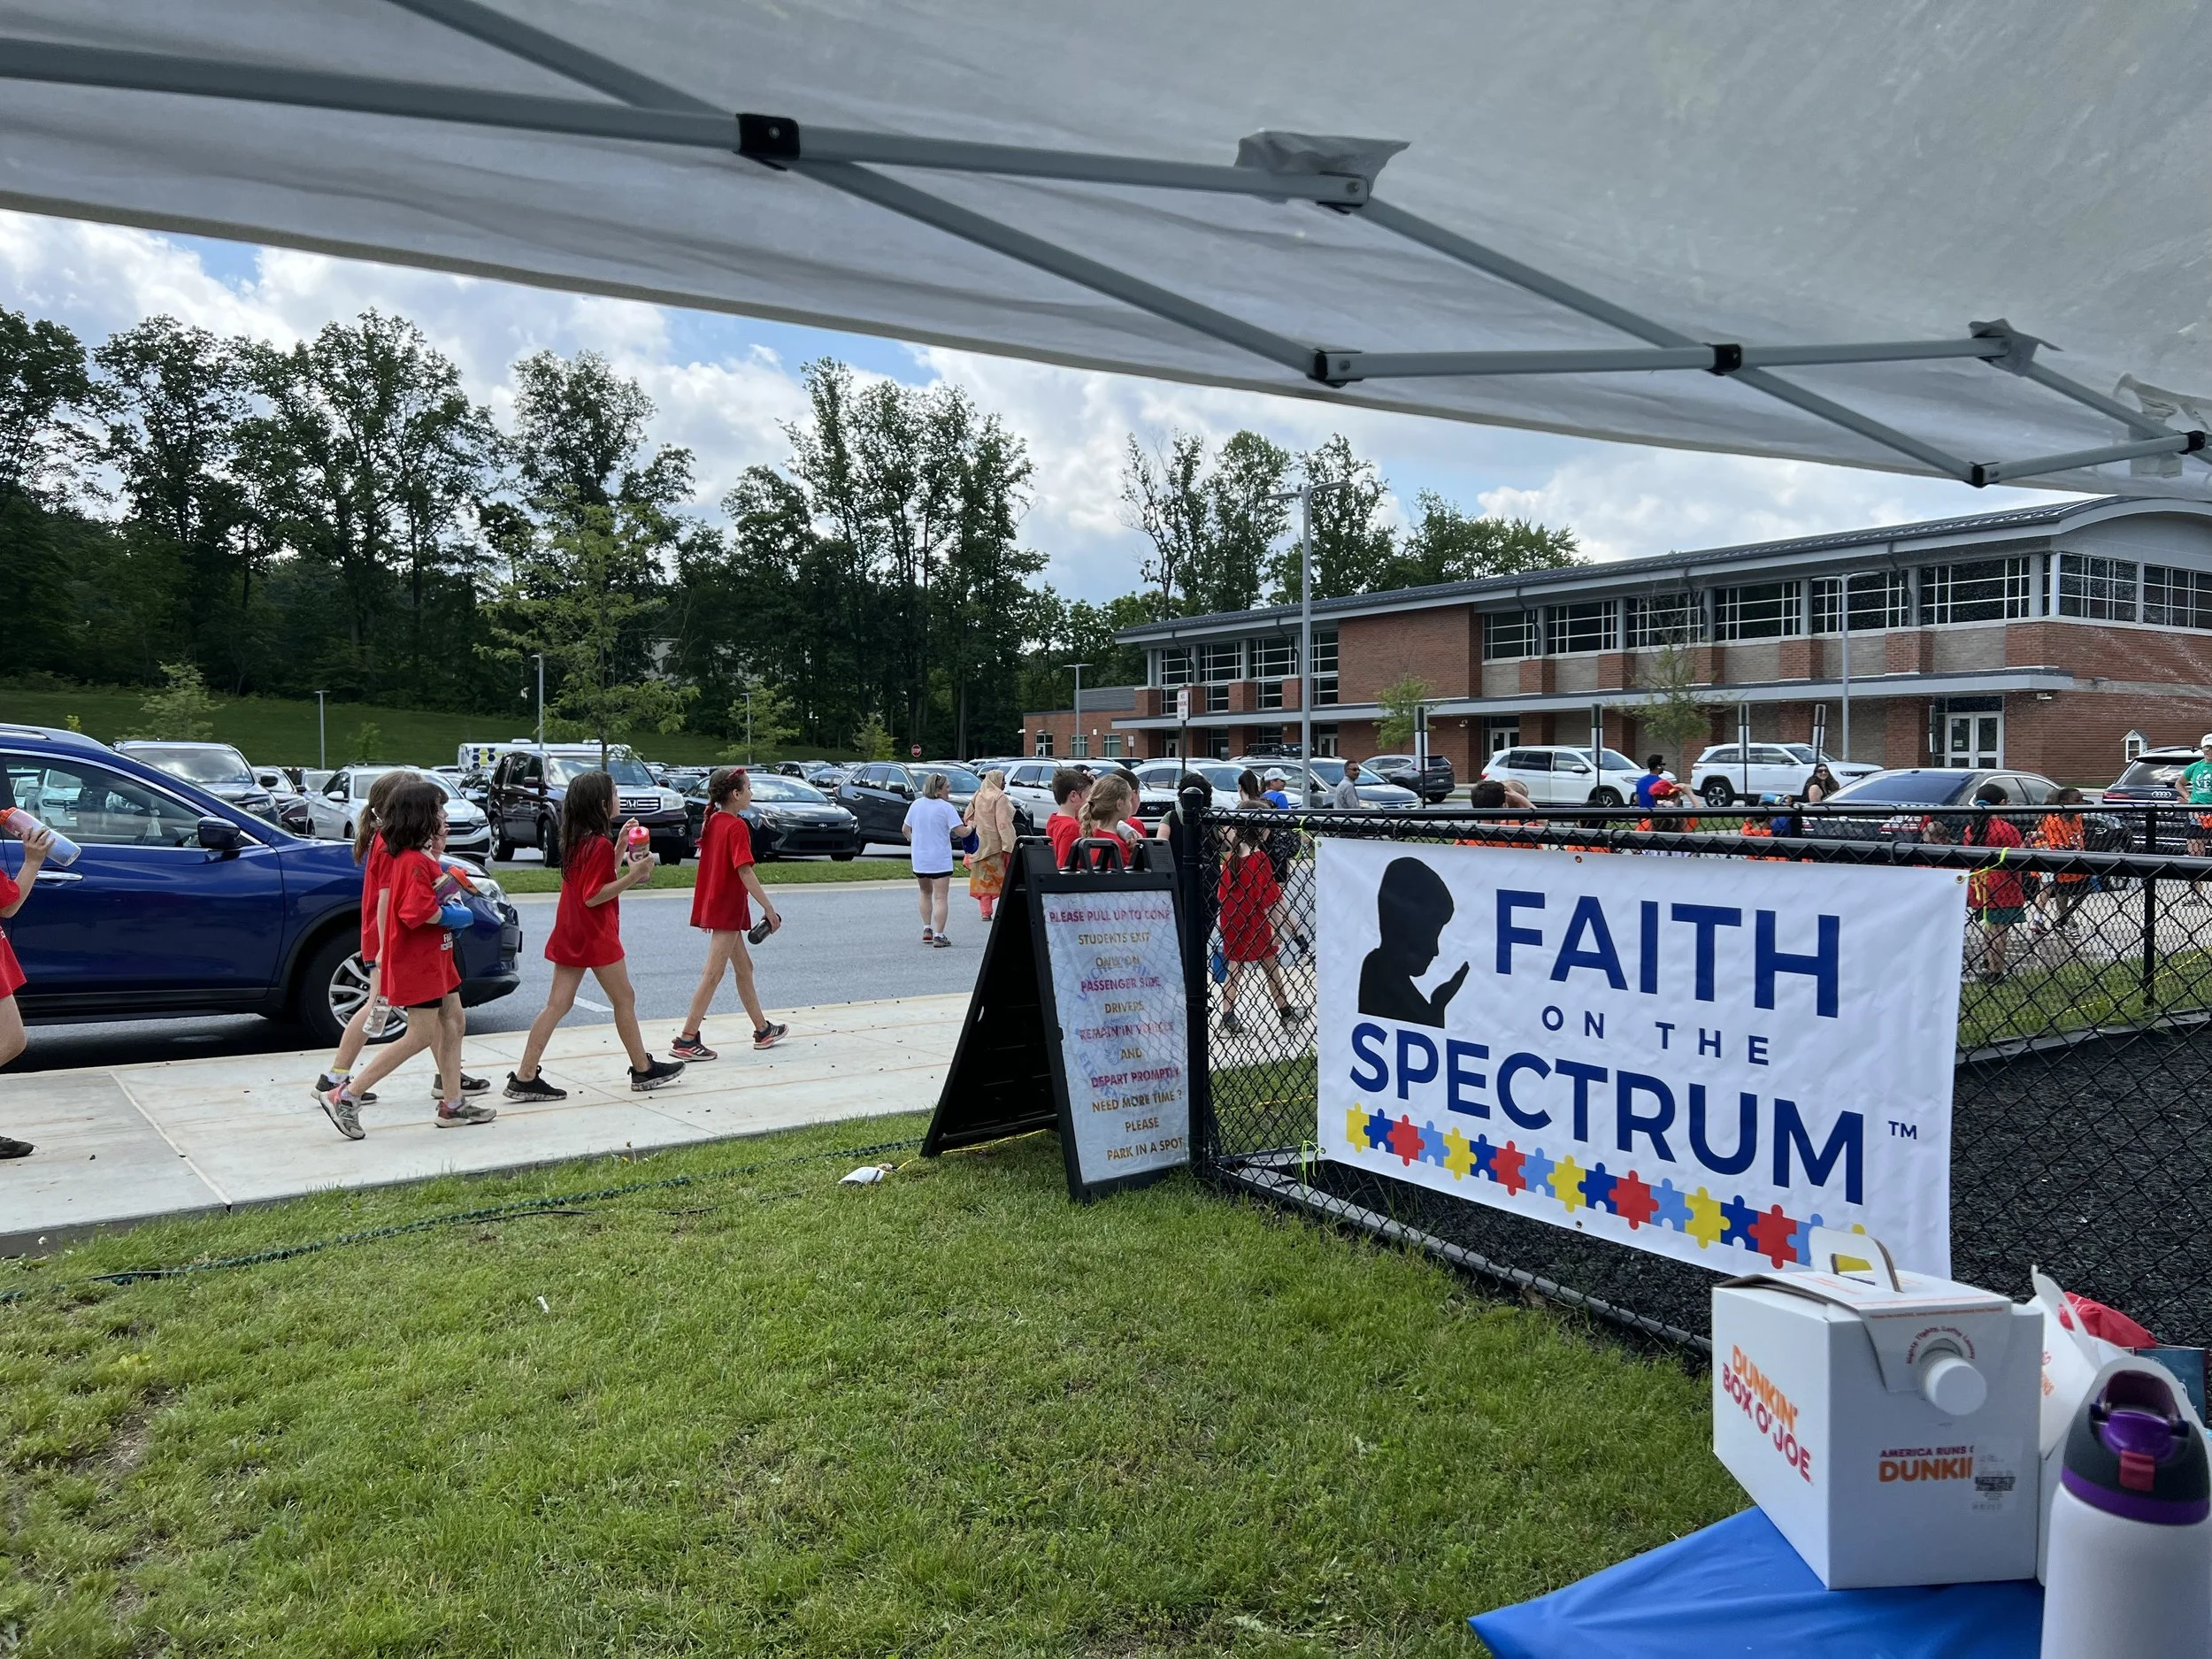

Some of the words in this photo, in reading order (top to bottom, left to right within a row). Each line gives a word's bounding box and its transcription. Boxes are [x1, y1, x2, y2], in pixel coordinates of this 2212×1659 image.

[1049, 910, 1084, 923] PLEASE
[1087, 910, 1111, 922] PULL
[1114, 910, 1127, 921] UP
[1129, 910, 1141, 920] TO
[1079, 933, 1127, 945] STUDENTS
[1130, 932, 1150, 943] EXIT
[1496, 888, 1839, 1018] FAITH
[1081, 979, 1137, 992] PASSENGER
[1105, 1001, 1145, 1013] DRIVERS
[1079, 1025, 1118, 1040] REMAIN
[1121, 1025, 1133, 1036] IN
[1541, 1005, 1605, 1039] ON
[1655, 1022, 1770, 1066] THE
[1121, 1048, 1142, 1060] AND
[1091, 1072, 1128, 1088] DEPART
[1131, 1066, 1179, 1083] PROMPTLY
[1092, 1099, 1118, 1112] NEED
[1122, 1094, 1149, 1109] MORE
[1153, 1091, 1175, 1103] TIME
[1350, 1022, 1864, 1206] SPECTRUM
[1125, 1117, 1159, 1133] PLEASE
[1108, 1146, 1133, 1160] PARK
[1136, 1143, 1148, 1156] IN
[1150, 1141, 1157, 1153] A
[1160, 1137, 1183, 1151] SPOT
[1723, 1363, 1752, 1419] BOX
[1772, 1425, 1811, 1483] JOE
[1879, 1448, 1933, 1458] AMERICA
[1937, 1446, 1966, 1455] RUNS
